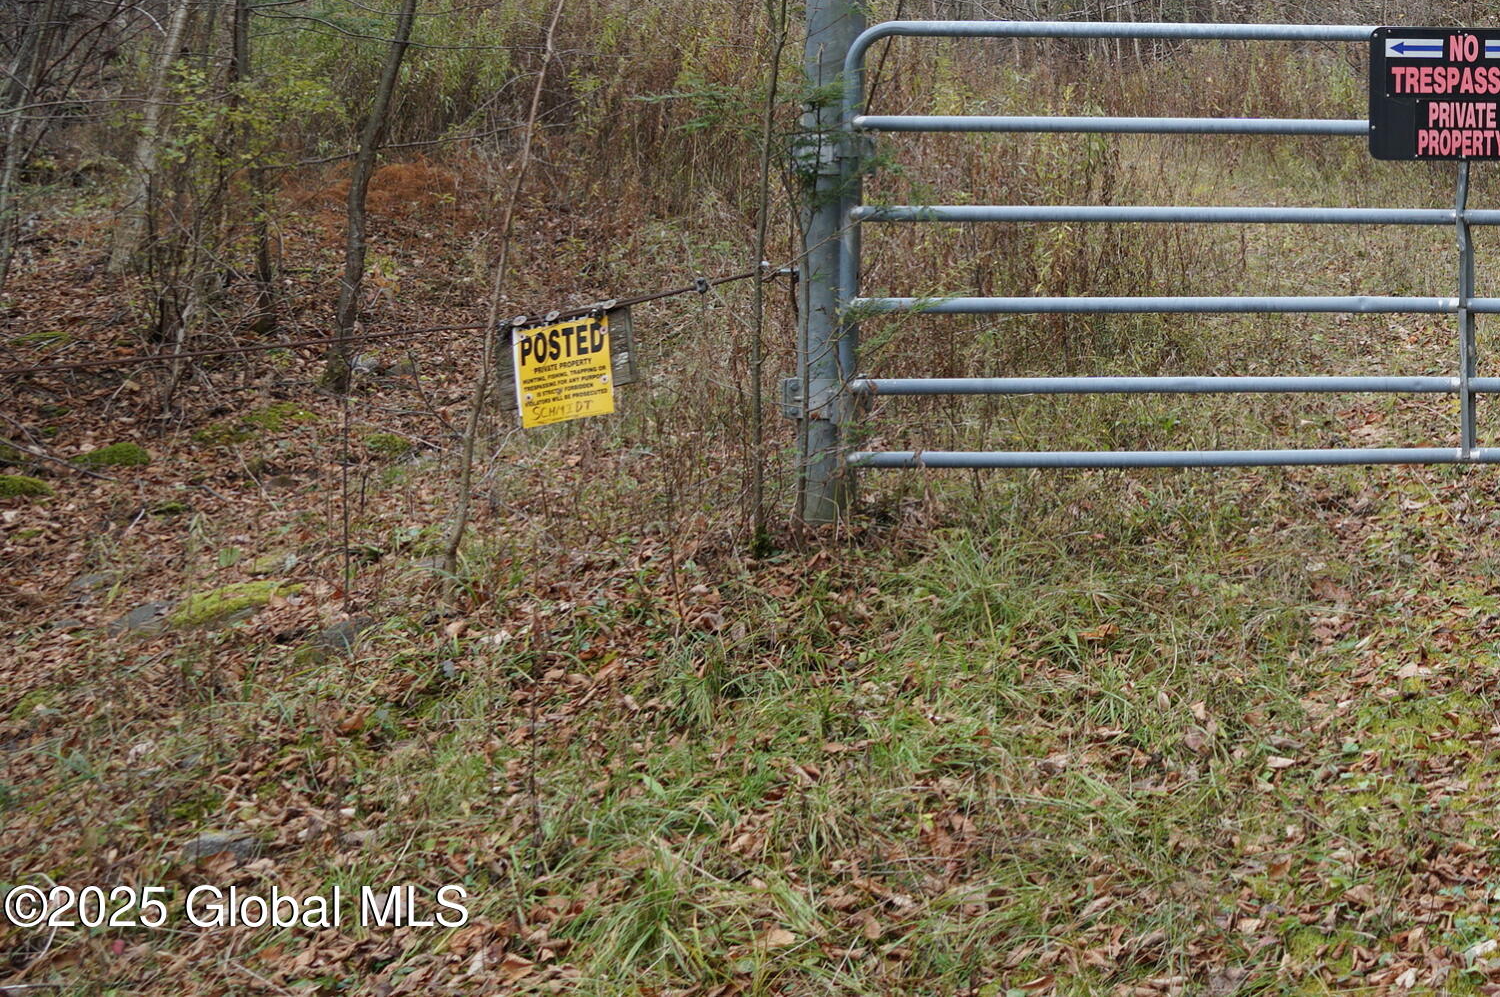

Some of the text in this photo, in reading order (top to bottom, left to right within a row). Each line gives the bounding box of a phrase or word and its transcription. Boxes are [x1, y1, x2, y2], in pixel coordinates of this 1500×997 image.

[1449, 34, 1479, 63] NO
[1428, 102, 1497, 128] PRIVATE
[521, 322, 604, 366] POSTED
[534, 358, 592, 374] PRIVATE PROPERTY
